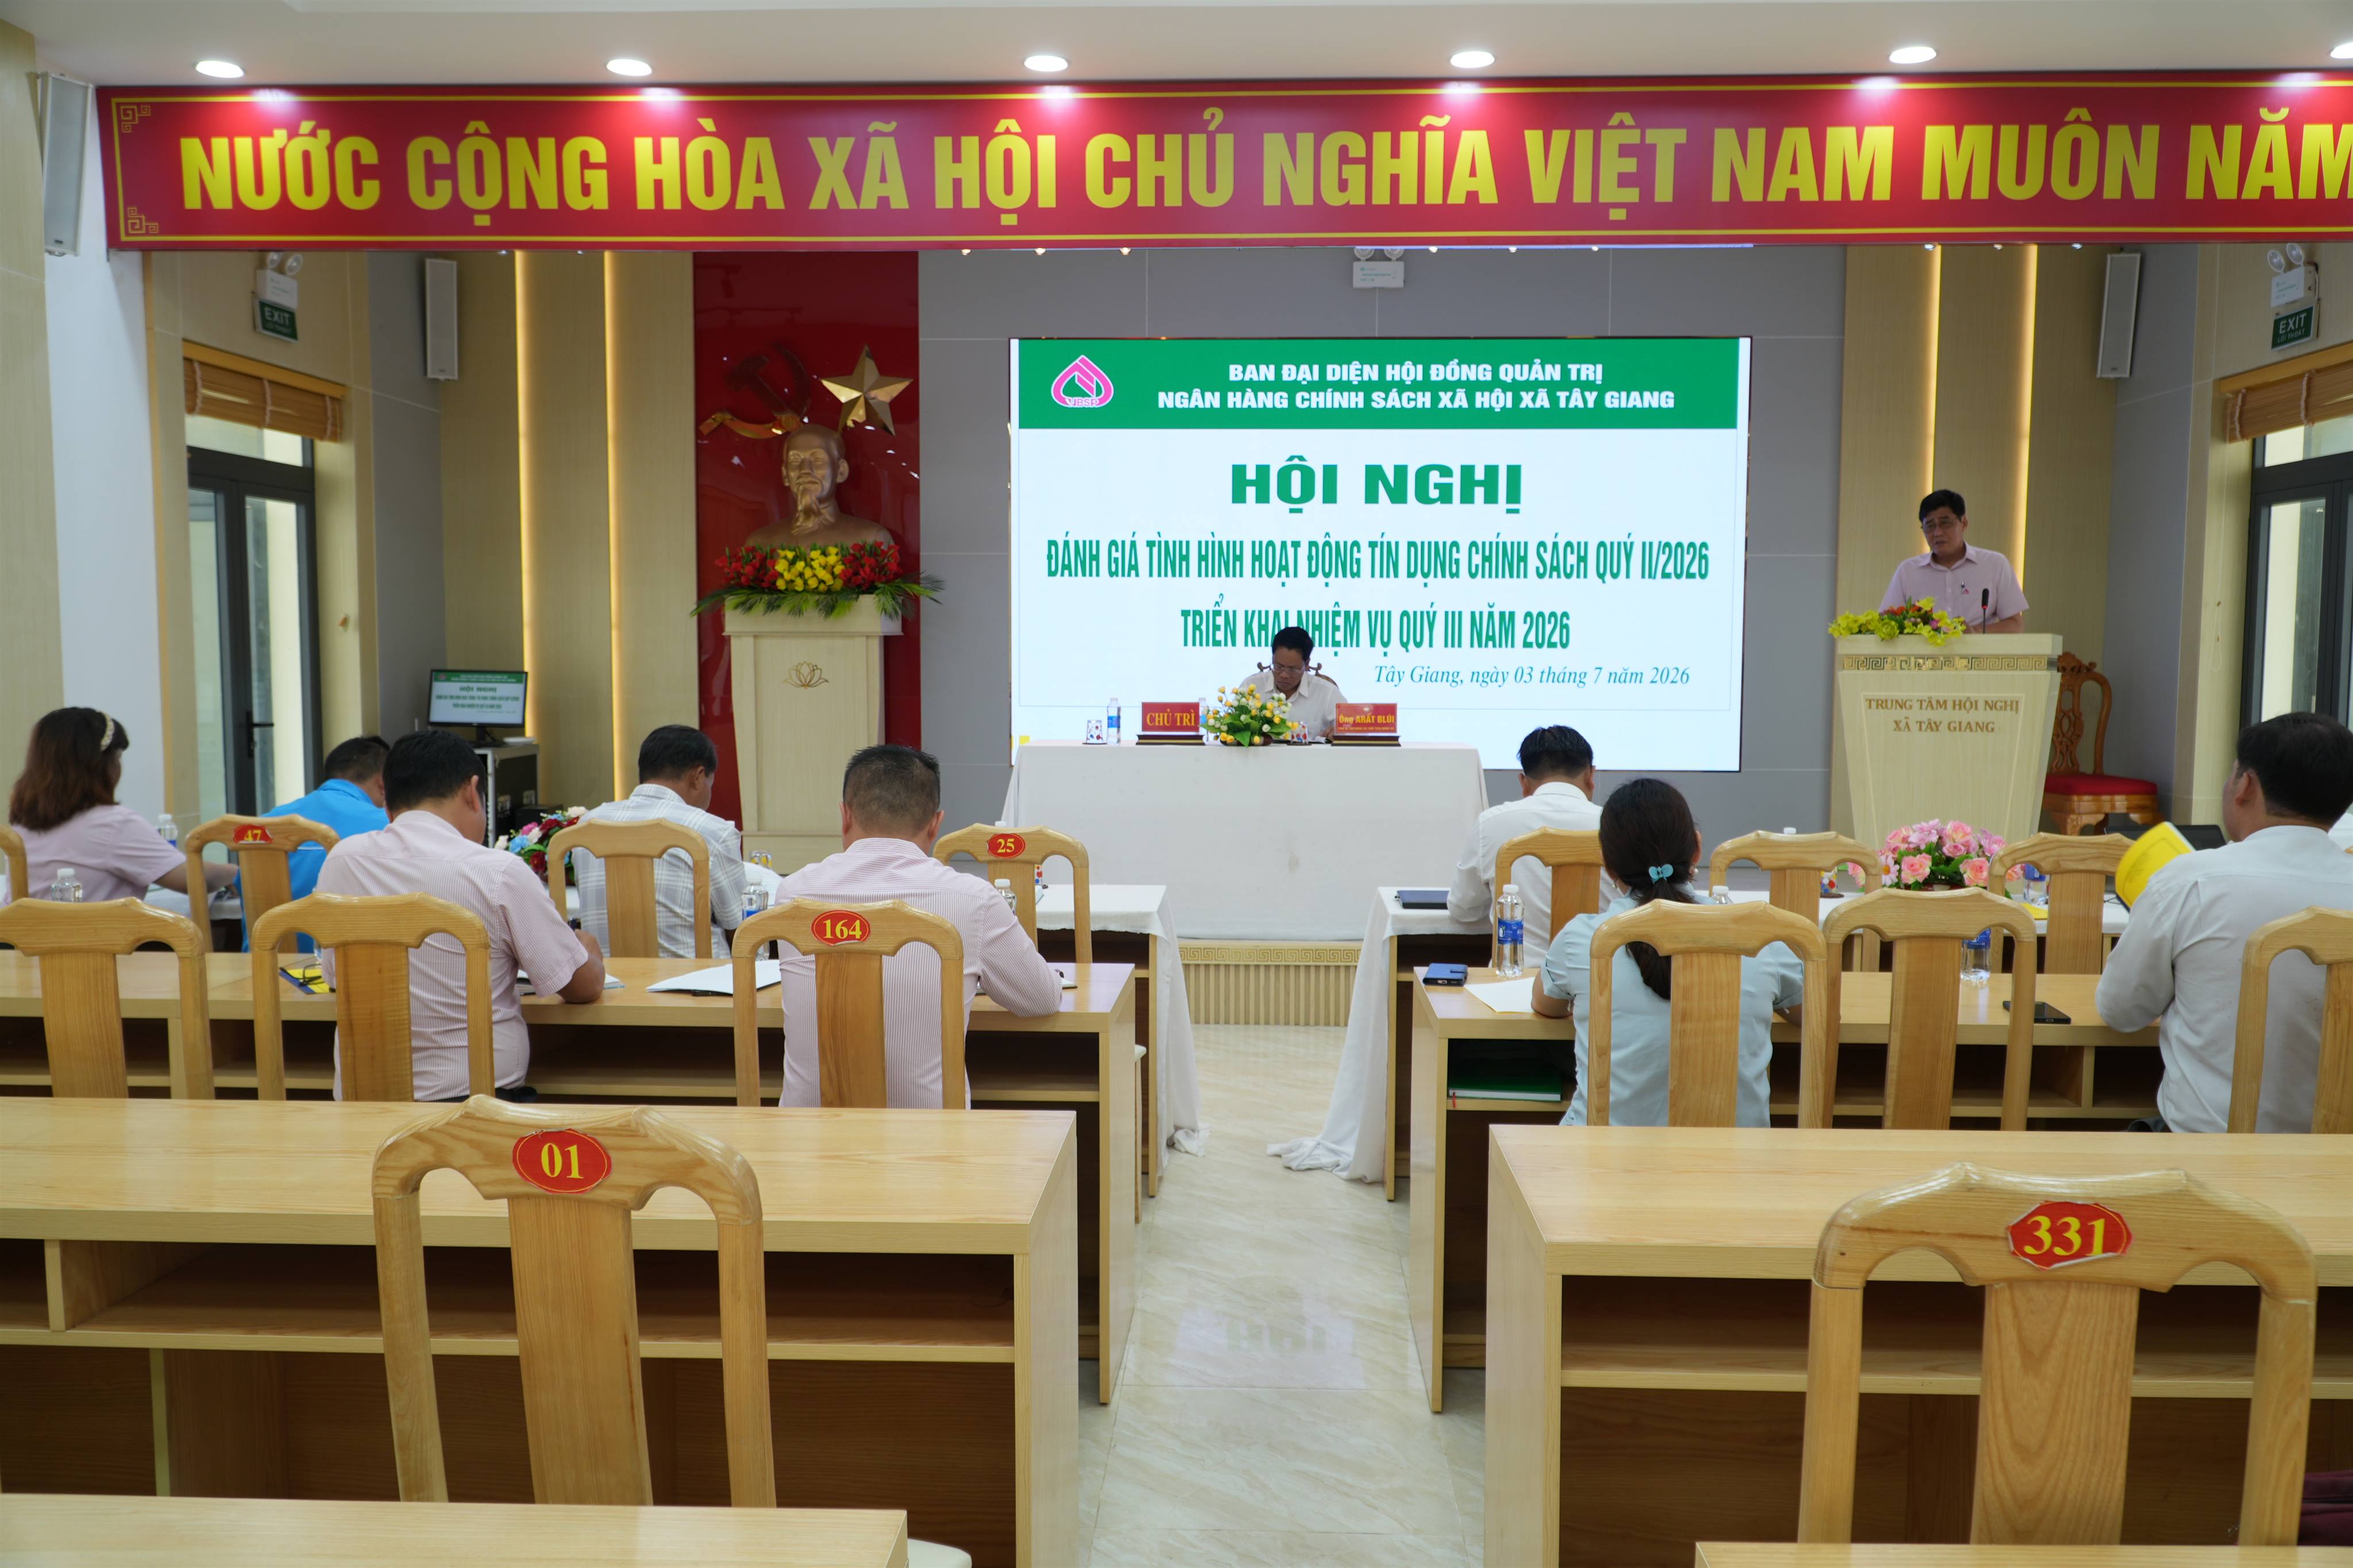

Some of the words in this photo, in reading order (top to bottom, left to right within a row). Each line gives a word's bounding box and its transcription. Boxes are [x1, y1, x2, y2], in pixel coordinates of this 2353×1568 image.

[180, 121, 380, 210] NƯỚC
[407, 122, 609, 226] CỘNG
[634, 118, 785, 210] HÒA
[809, 120, 909, 209] XÃ
[935, 118, 1057, 225] HỘI
[1085, 107, 1234, 208] CHỦ
[1263, 114, 1498, 205] NGHĨA
[1524, 113, 1686, 220] VIỆT
[1712, 125, 1895, 202] NAM
[1922, 107, 2160, 200] MUÔN
[2185, 107, 2353, 200] NĂM
[265, 308, 290, 326] EXIT
[2279, 313, 2306, 334] EXIT
[1229, 364, 1276, 381] BAN
[1281, 364, 1320, 385] ĐẠI
[1326, 361, 1379, 385] DIỆN
[1386, 361, 1424, 385] HỘI
[1429, 359, 1492, 381] ĐỒNG
[1499, 359, 1561, 382] QUẢN
[1568, 364, 1603, 384] TRỊ
[1158, 388, 1221, 408] NGÂN
[1227, 388, 1289, 408] HÀNG
[1295, 388, 1364, 408] CHÍNH
[1371, 388, 1431, 408] SÁCH
[1438, 388, 1469, 408] XÃ
[1475, 388, 1513, 412] HỘI
[1519, 388, 1550, 408] XÃ
[1557, 388, 1599, 408] TÂY
[1604, 391, 1675, 408] GIANG
[1232, 455, 1338, 513] HỘI
[1364, 464, 1522, 514] NGHỊ
[1046, 531, 1100, 578] ĐÁNH
[1108, 531, 1140, 578] GIÁ
[1145, 531, 1190, 578] TÌNH
[1197, 531, 1244, 578] HÌNH
[1251, 539, 1302, 588] HOẠT
[1307, 531, 1361, 588] ĐỘNG
[1368, 532, 1399, 579] TÍN
[1406, 540, 1460, 588] DỤNG
[1468, 532, 1529, 580] CHÍNH
[1536, 532, 1588, 580] SÁCH
[1595, 532, 1634, 584] QUÝ
[1641, 540, 1710, 580] II/2026
[1181, 593, 1237, 647] TRIỂN
[1367, 610, 1392, 657] VỤ
[1399, 602, 1438, 653] QUÝ
[1444, 611, 1463, 648] III
[1469, 603, 1516, 649] NĂM
[1522, 610, 1571, 650] 2026
[1375, 665, 1406, 688] Tây
[1410, 666, 1464, 688] Giang,
[1470, 666, 1510, 688] ngày
[1514, 666, 1534, 683] 03
[1539, 666, 1588, 688] tháng
[1594, 666, 1603, 683] 7
[1608, 668, 1644, 684] năm
[1649, 667, 1690, 684] 2026
[1865, 698, 1914, 710] TRUNG
[1916, 697, 1949, 711] TÂM
[1952, 697, 1979, 713] HỘI
[1984, 699, 2020, 714] NGHỊ
[1146, 708, 1172, 727] CHỦ
[1175, 709, 1196, 727] TRÌ
[1338, 713, 1354, 724] Ông
[1893, 716, 1912, 732] XÃ
[1915, 718, 1942, 732] TÂY
[1947, 720, 1996, 733] GIANG
[244, 829, 263, 842] 47
[996, 837, 1016, 854] 25
[823, 919, 862, 940] 164
[541, 1142, 585, 1180] 01
[2023, 1215, 2106, 1257] 331
